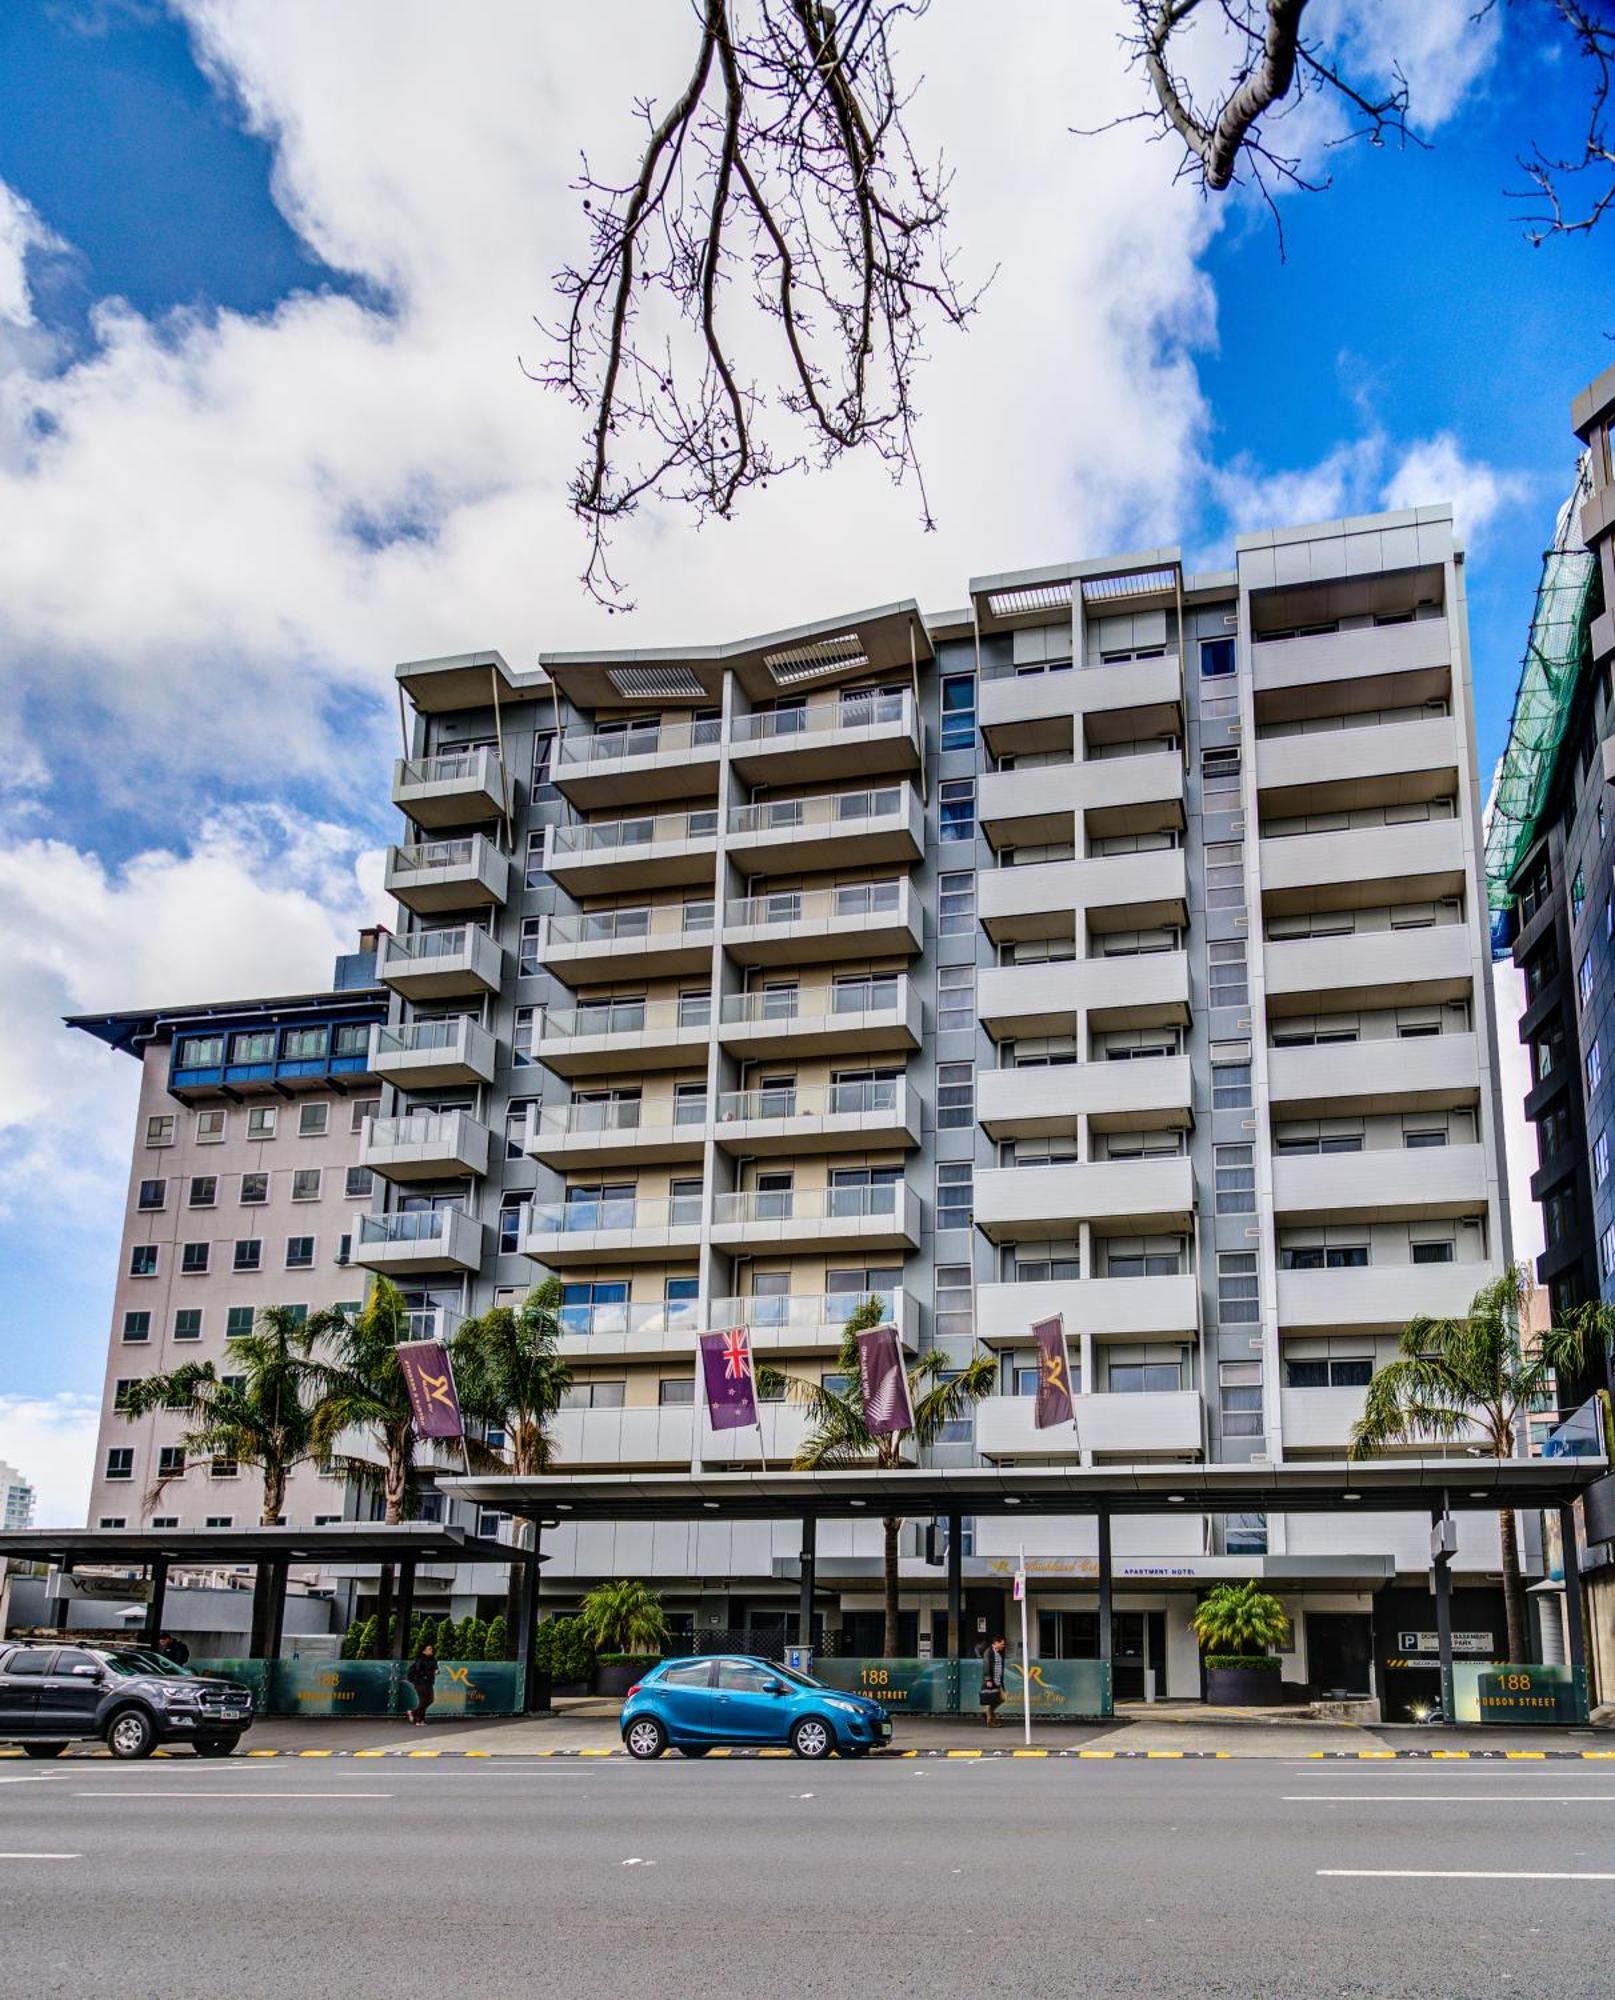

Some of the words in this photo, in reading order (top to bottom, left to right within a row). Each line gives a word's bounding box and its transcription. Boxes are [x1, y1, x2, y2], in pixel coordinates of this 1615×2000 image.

[1404, 1635, 1415, 1648] P
[861, 1669, 889, 1685] 188
[1496, 1674, 1531, 1690] 188
[877, 1690, 909, 1700] STREET
[1519, 1697, 1556, 1707] STREET
